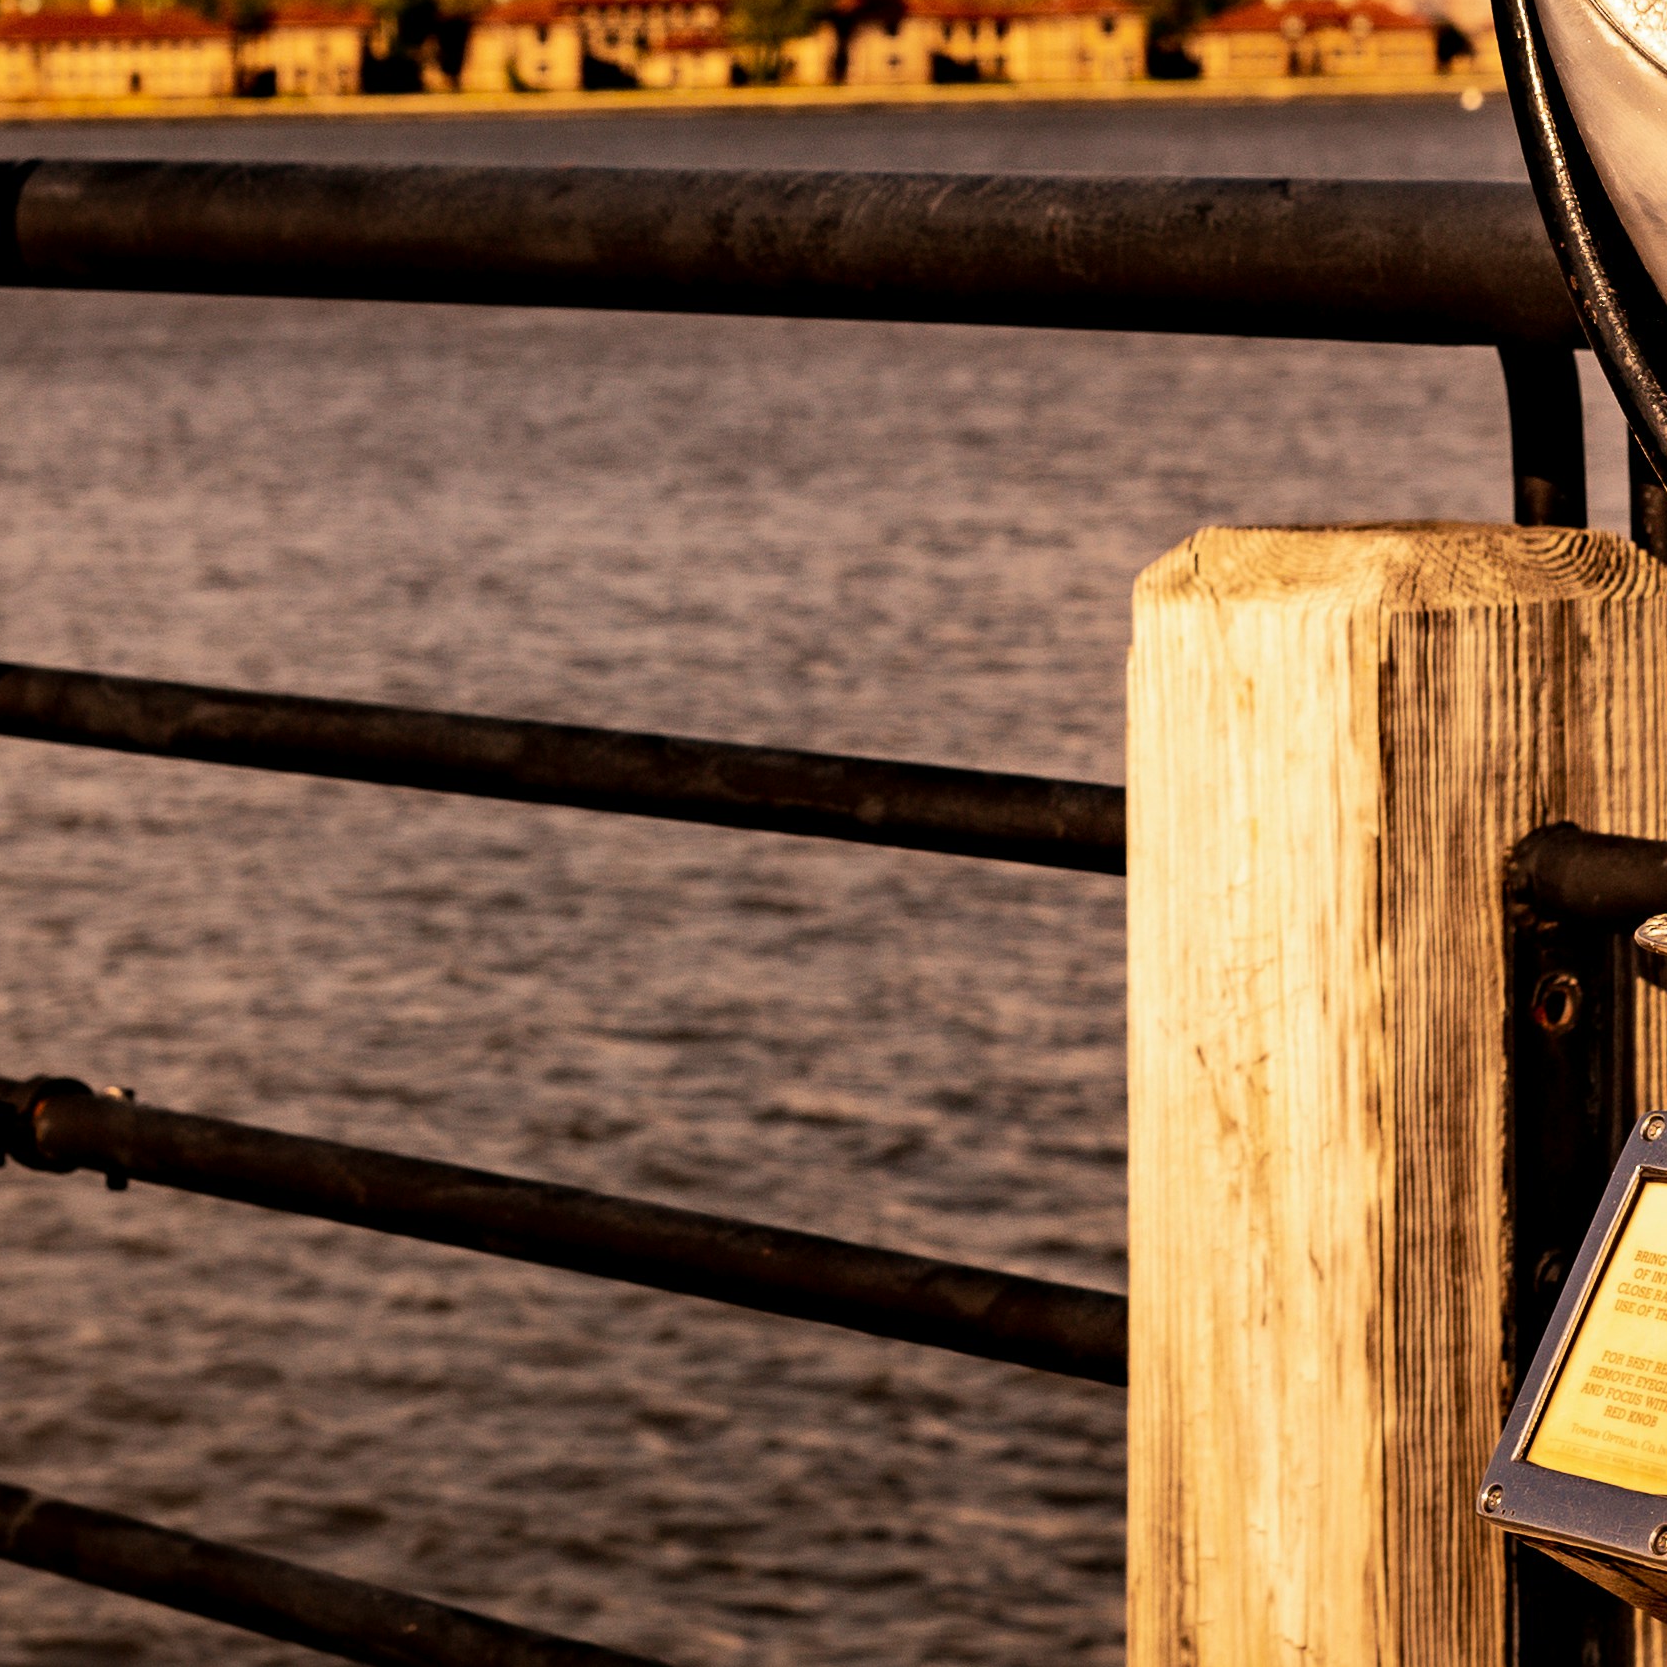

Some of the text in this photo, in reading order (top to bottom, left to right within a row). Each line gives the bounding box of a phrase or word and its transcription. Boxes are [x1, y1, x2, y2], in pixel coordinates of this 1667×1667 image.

[1634, 1250, 1667, 1269] BRING
[1634, 1268, 1651, 1282] OF
[1617, 1282, 1652, 1300] CLOSE
[1614, 1299, 1635, 1315] USE
[1637, 1304, 1654, 1318] OF
[1601, 1350, 1624, 1365] FOR
[1626, 1355, 1654, 1372] BEST
[1589, 1365, 1635, 1387] REMOVE
[1581, 1382, 1605, 1397] AND
[1605, 1387, 1643, 1406] FOCUS
[1604, 1405, 1659, 1428] RED KNOB
